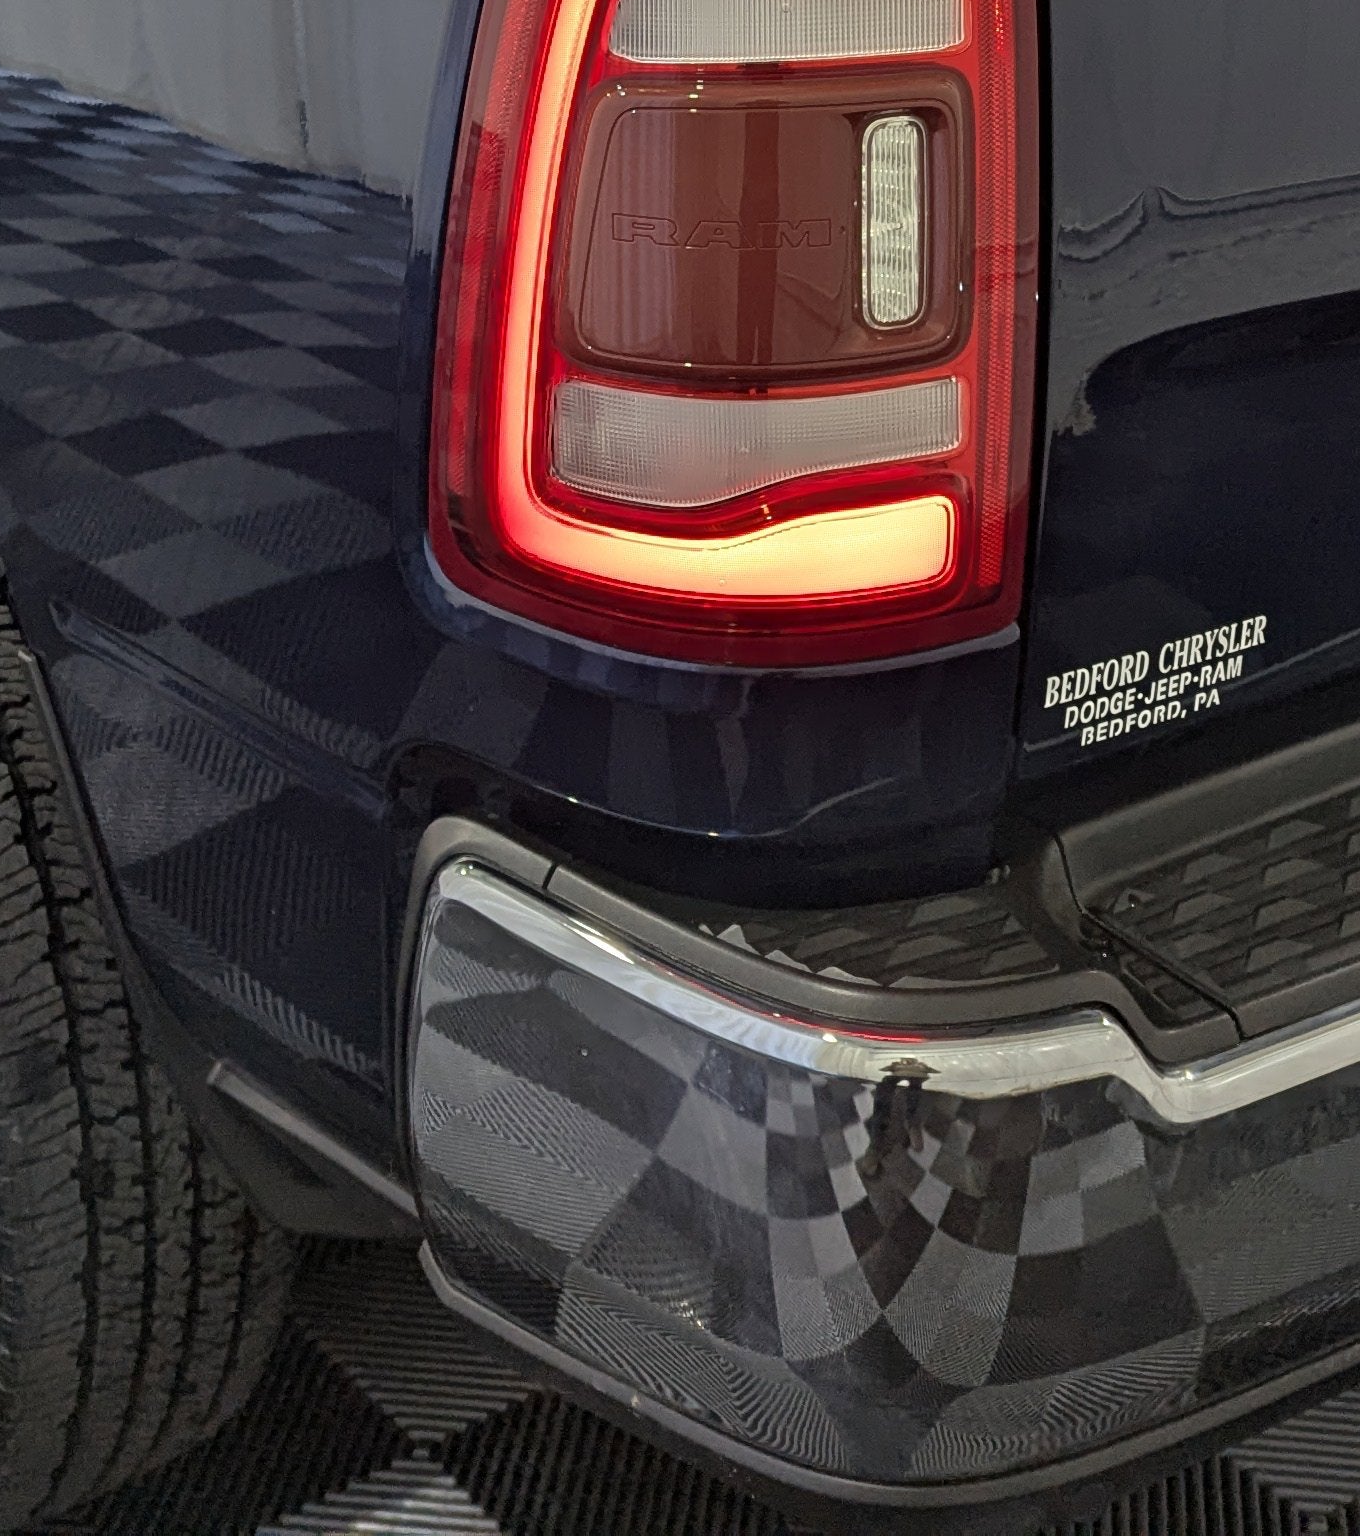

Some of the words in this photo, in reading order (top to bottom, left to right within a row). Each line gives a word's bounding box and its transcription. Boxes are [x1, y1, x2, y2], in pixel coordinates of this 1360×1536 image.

[612, 212, 832, 251] RAM
[1043, 650, 1150, 709] BEDFORD
[1158, 615, 1268, 674] CHRYSLER
[1080, 700, 1188, 747] BEDFORD,
[1193, 688, 1221, 712] PA
